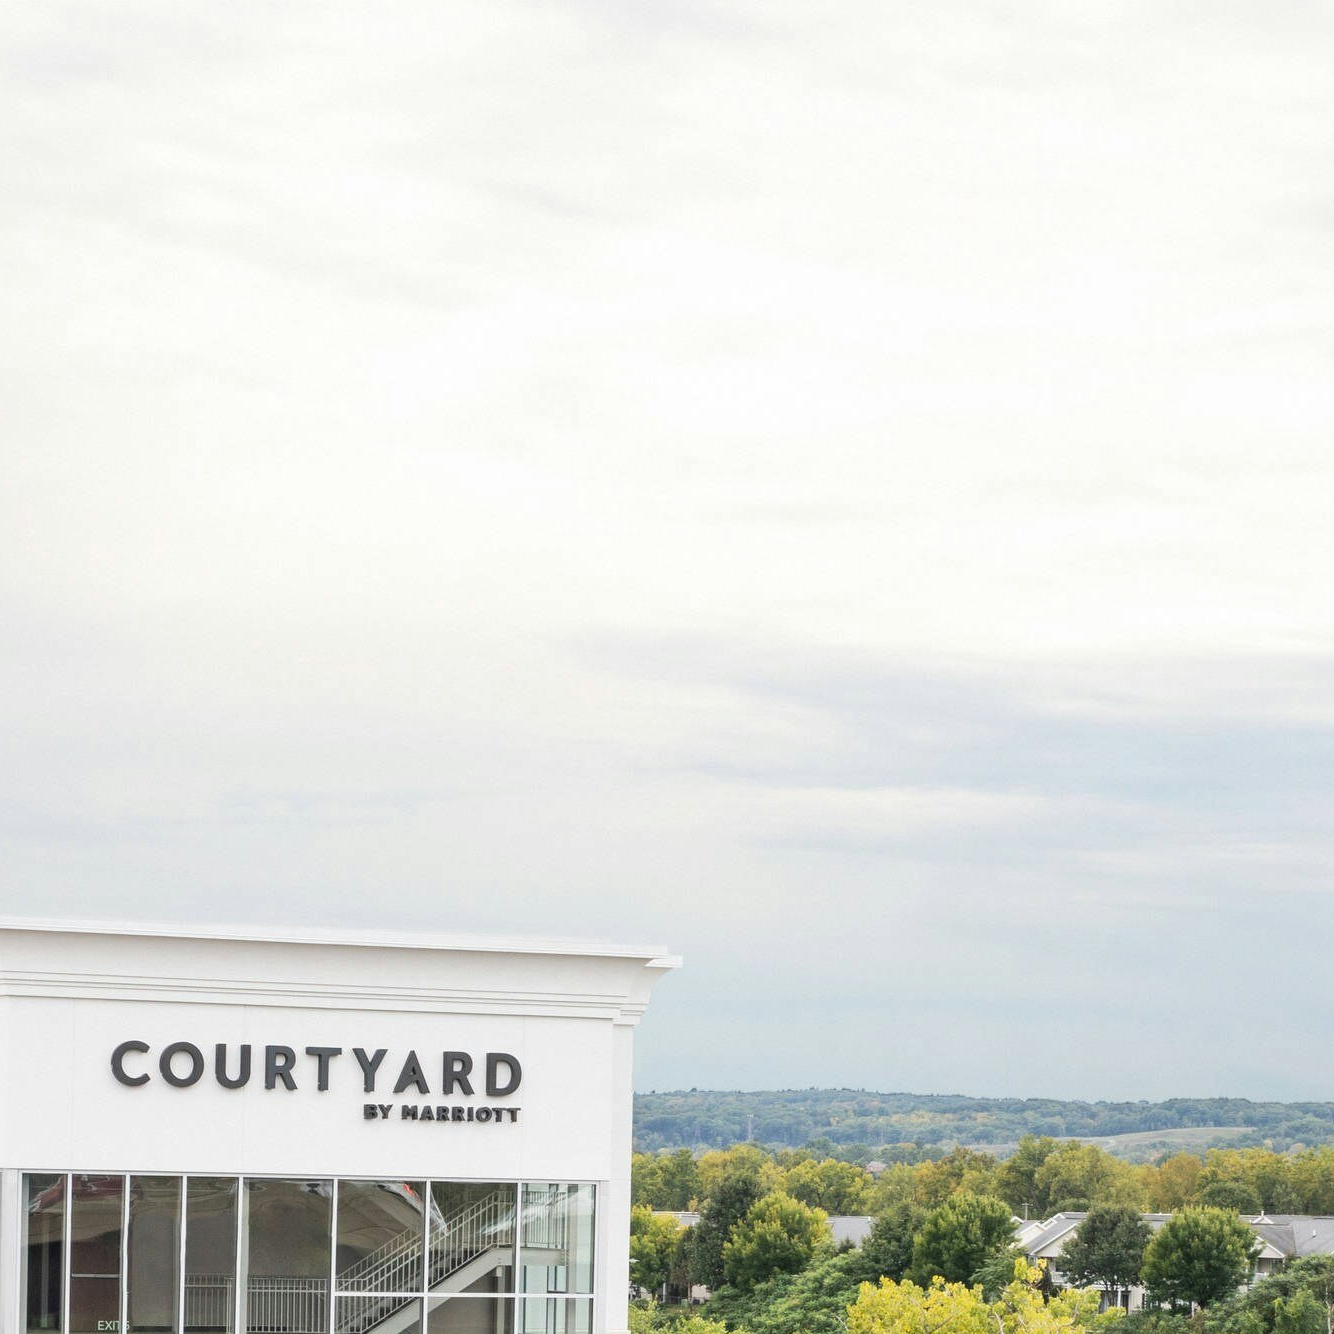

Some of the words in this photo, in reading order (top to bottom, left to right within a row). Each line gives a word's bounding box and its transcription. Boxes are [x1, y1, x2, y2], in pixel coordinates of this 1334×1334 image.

[110, 1040, 522, 1097] COURTYARD
[364, 1104, 393, 1120] BY
[401, 1105, 521, 1123] MARRIOTT
